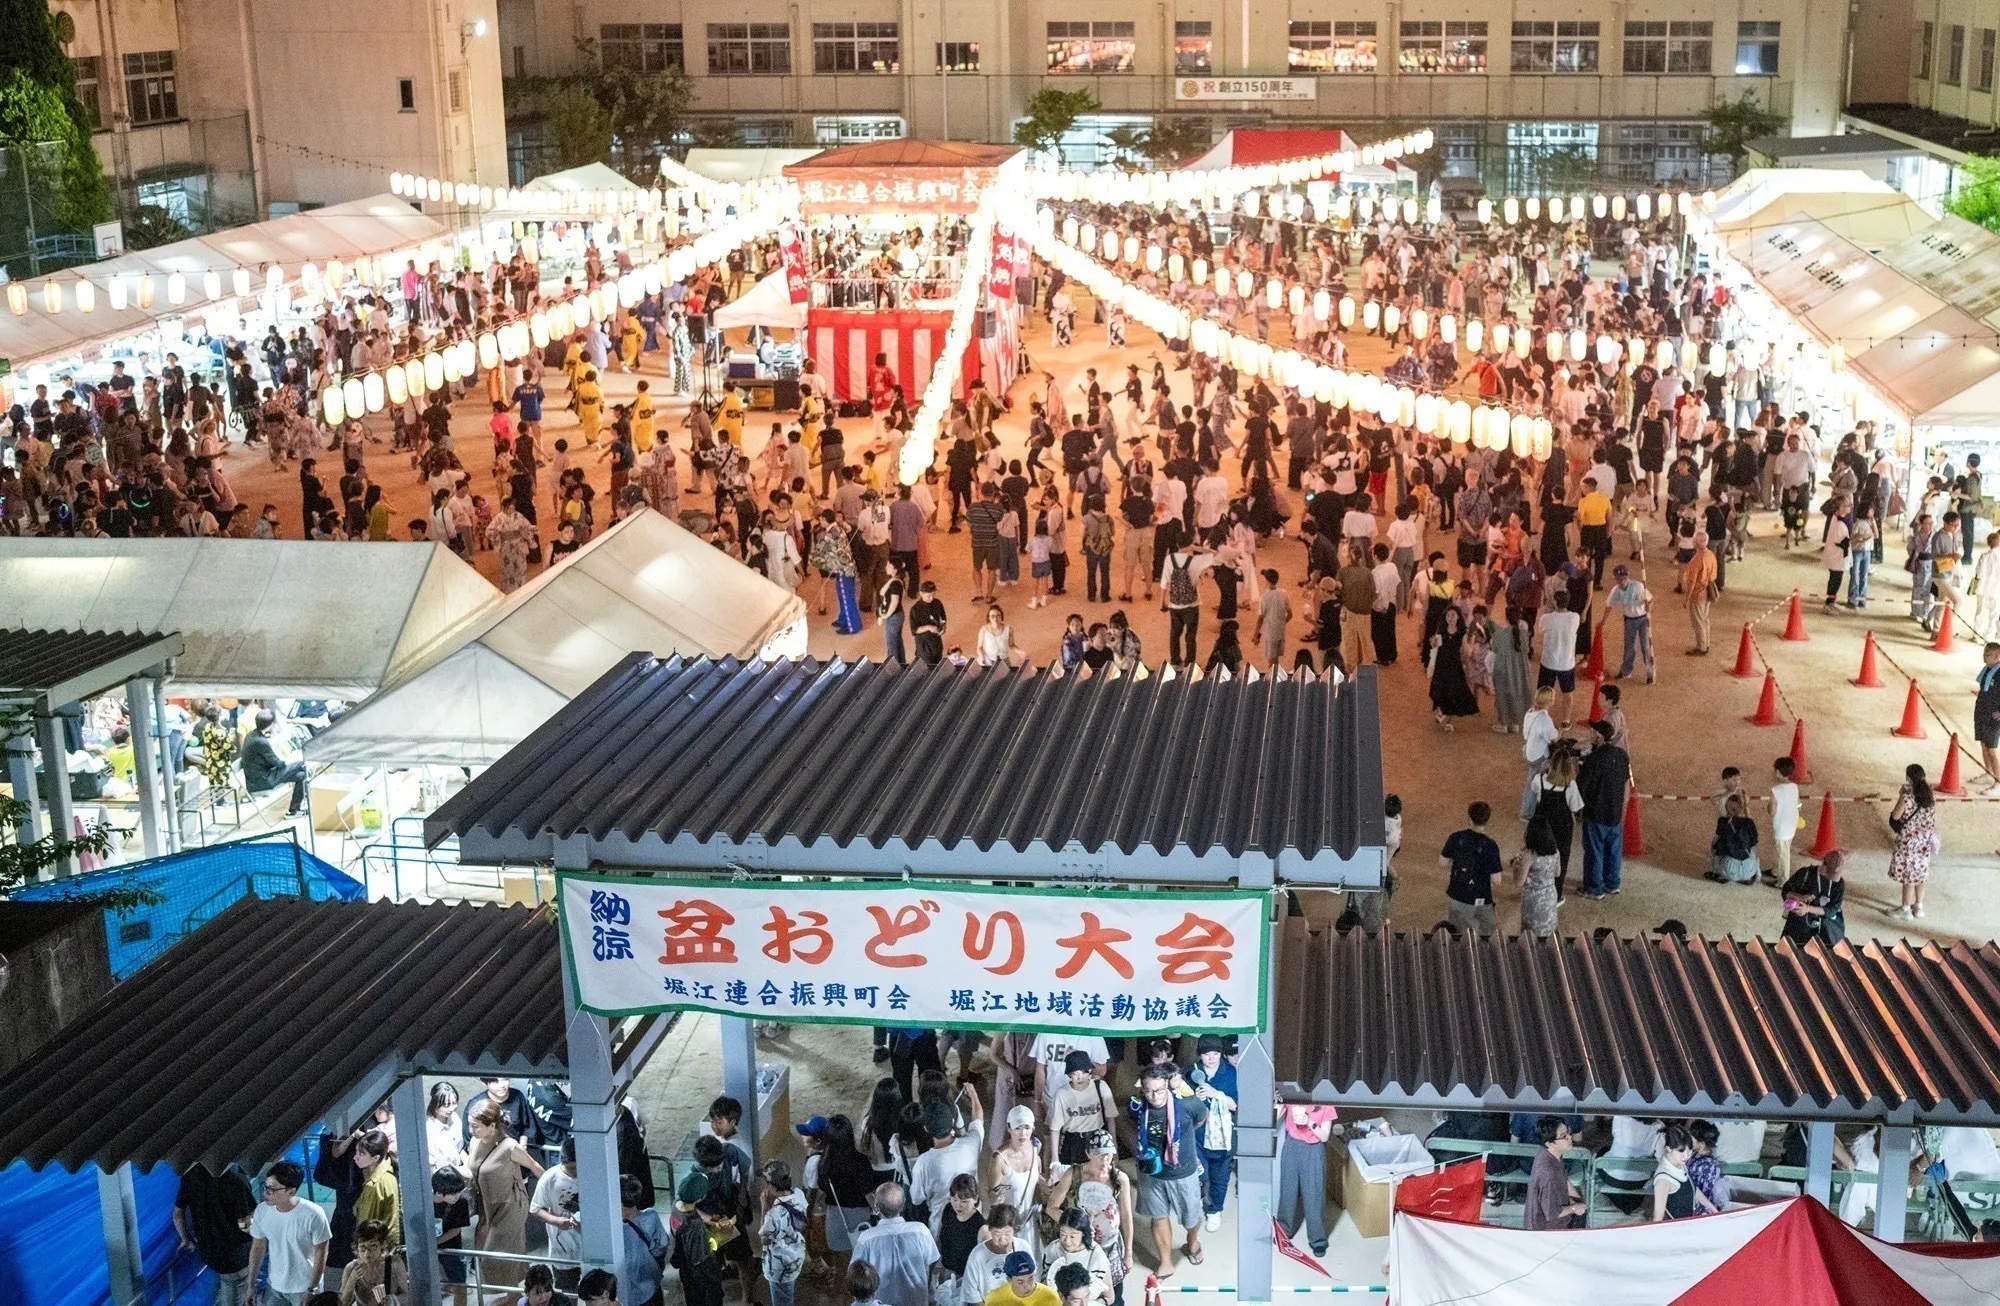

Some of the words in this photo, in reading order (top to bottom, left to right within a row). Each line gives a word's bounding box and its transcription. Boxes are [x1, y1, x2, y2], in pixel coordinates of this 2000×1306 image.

[1218, 80, 1294, 93] 創立150周年
[802, 180, 983, 204] 堀江連合振興町会
[589, 889, 635, 962] 納涼
[657, 898, 1236, 985] 盆おどり大会
[663, 976, 912, 1011] 堀江連合振興町会
[948, 988, 1233, 1022] 堀江地域活動協議会
[1046, 1043, 1073, 1063] SE
